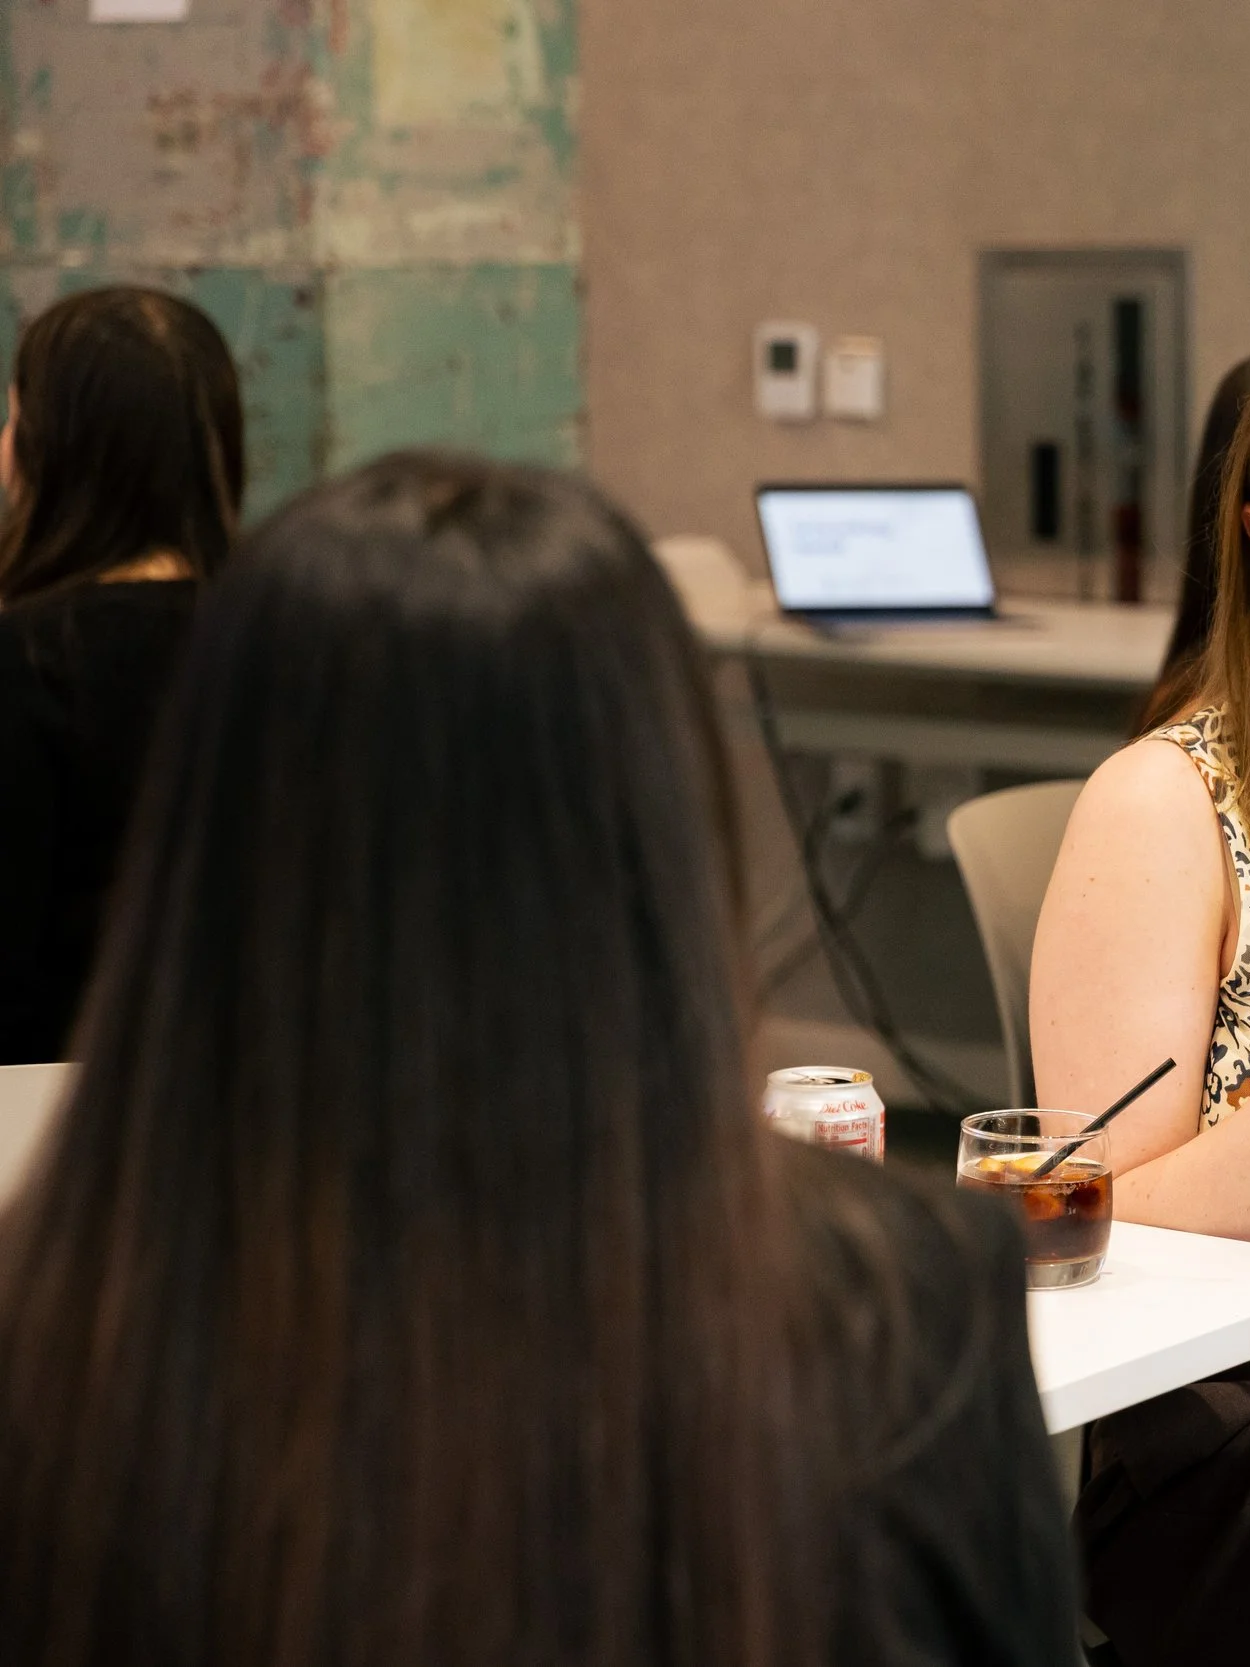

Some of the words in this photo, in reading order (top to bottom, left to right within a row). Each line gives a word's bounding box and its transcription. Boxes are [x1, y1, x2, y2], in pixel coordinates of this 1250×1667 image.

[819, 1103, 841, 1114] Diet
[842, 1100, 867, 1112] Coke
[817, 1123, 849, 1133] Nutrition
[851, 1120, 867, 1131] Facts
